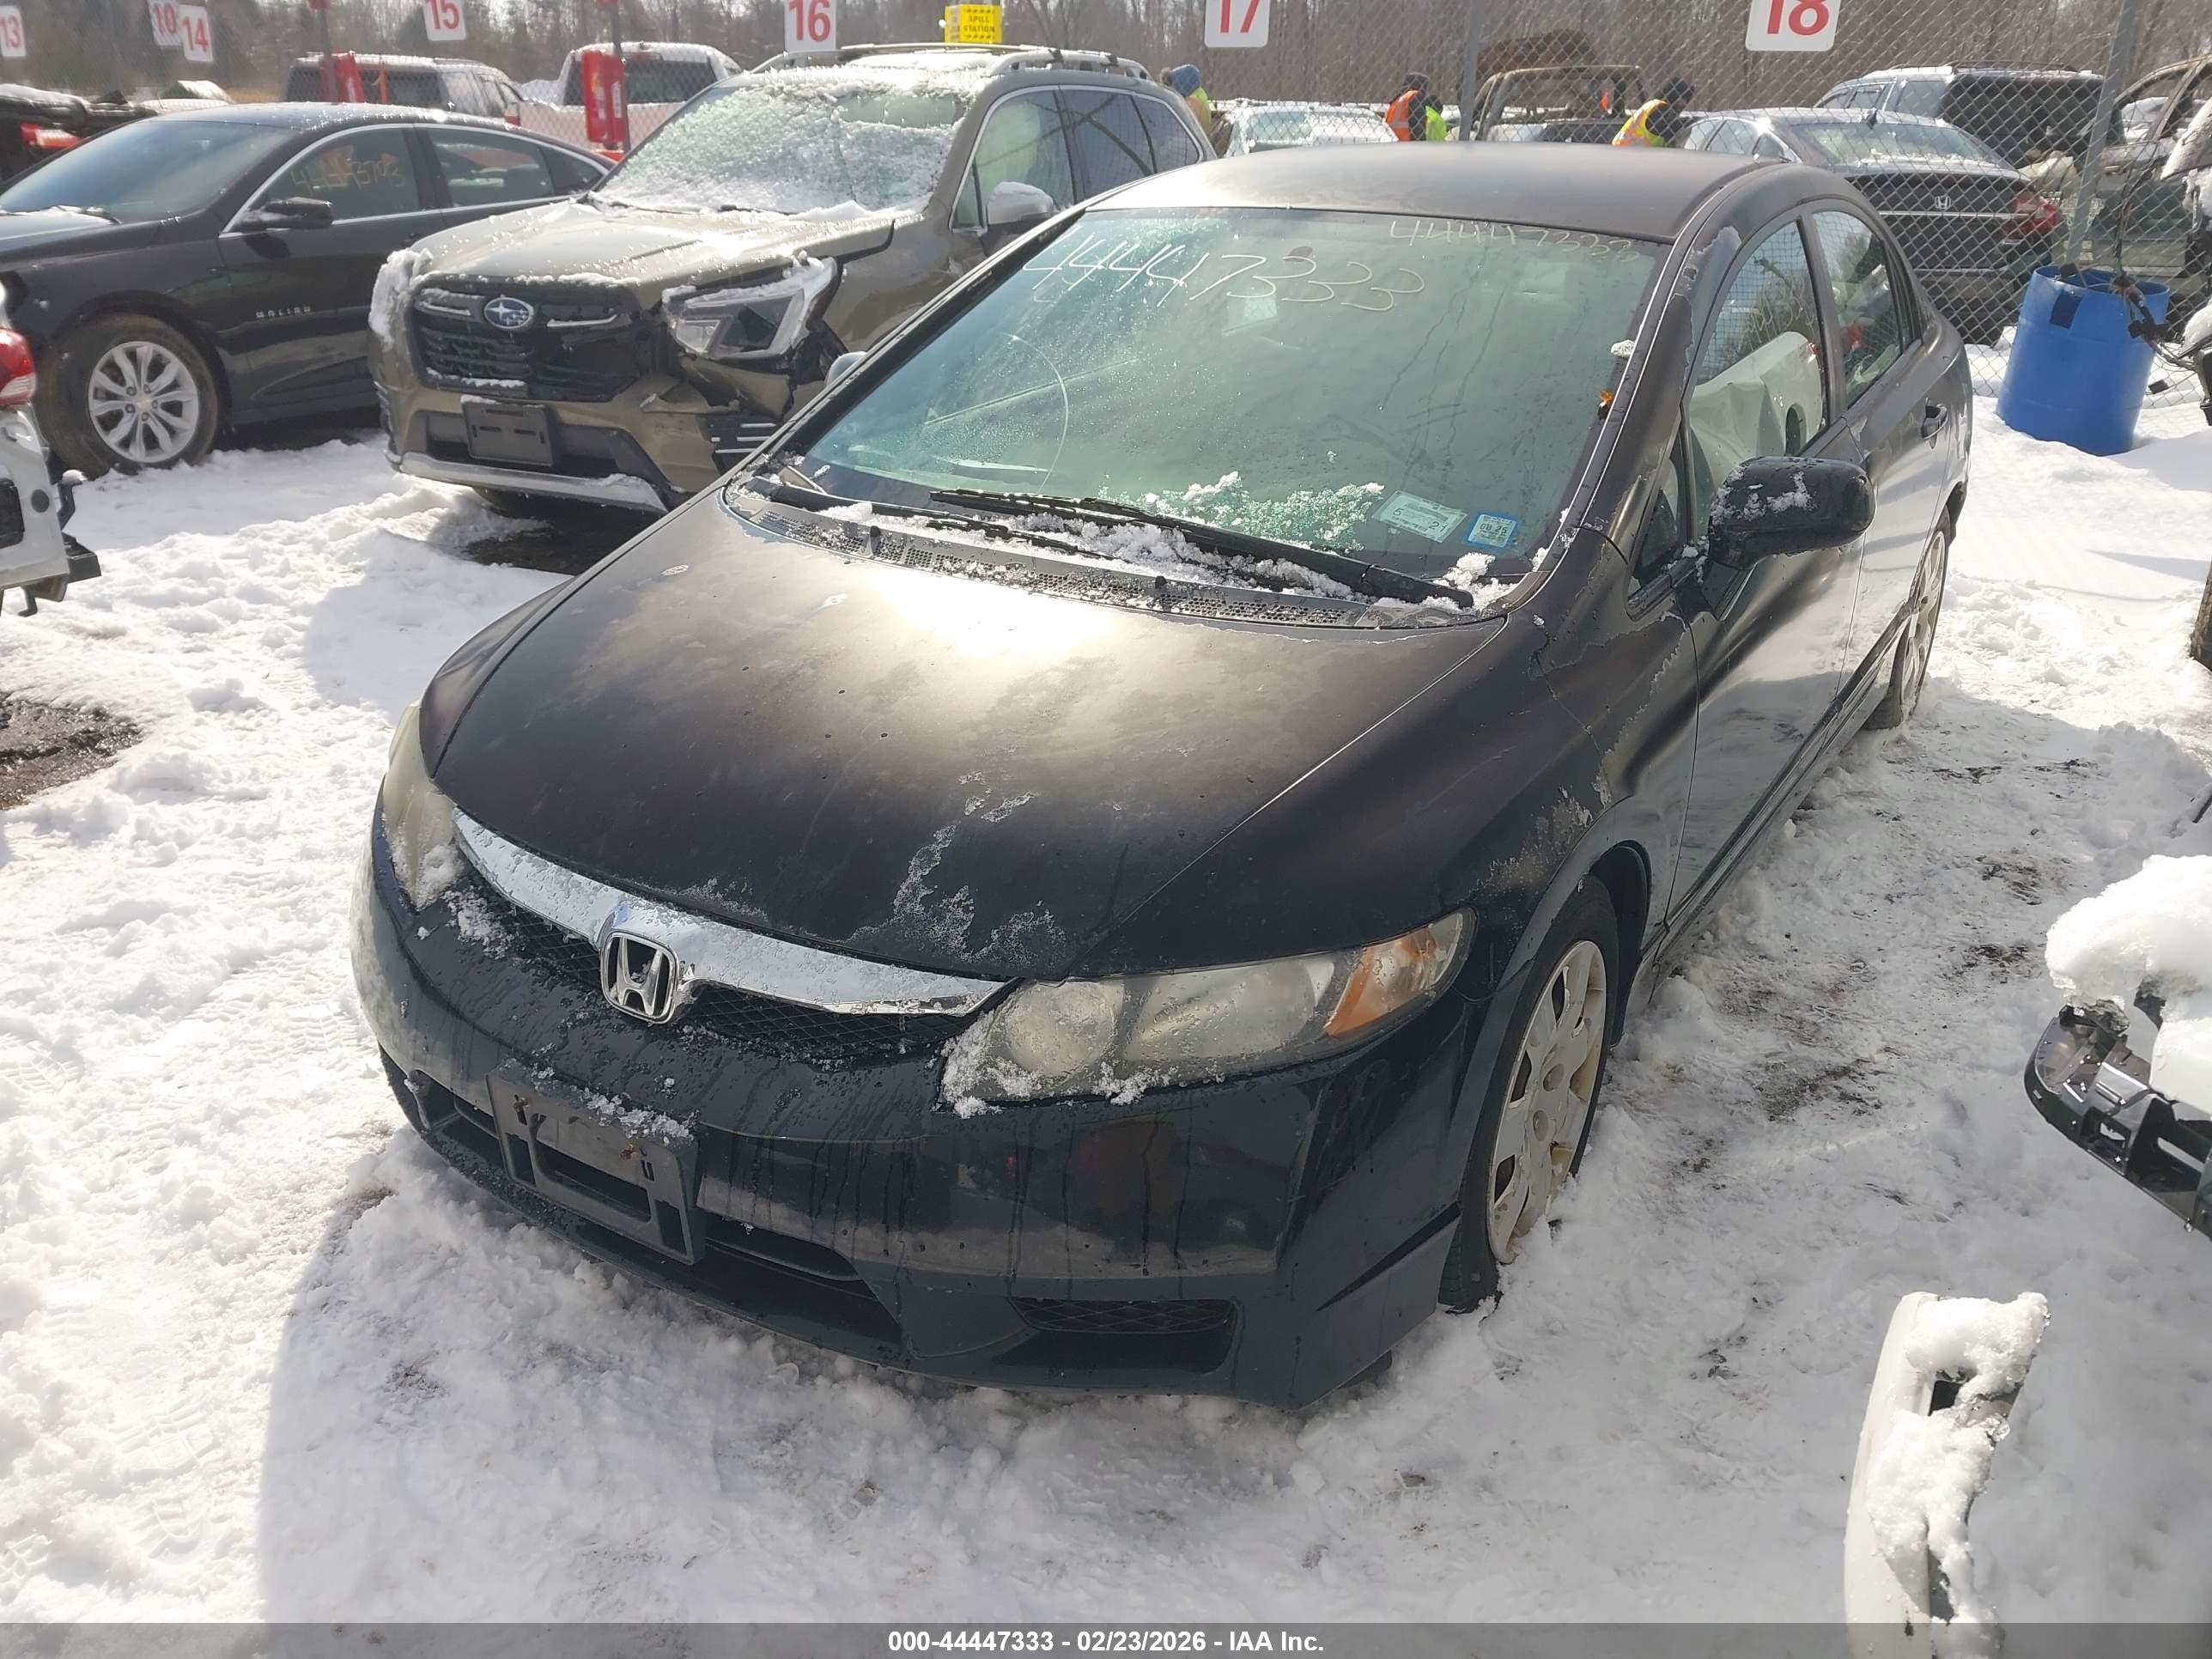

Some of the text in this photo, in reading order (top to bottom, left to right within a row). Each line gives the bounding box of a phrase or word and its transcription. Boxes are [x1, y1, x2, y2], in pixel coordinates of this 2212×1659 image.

[181, 16, 208, 52] 14
[426, 0, 459, 29] 15
[788, 0, 830, 42] 16
[1390, 220, 1641, 262] 44447333
[1022, 227, 1424, 311] 44447333
